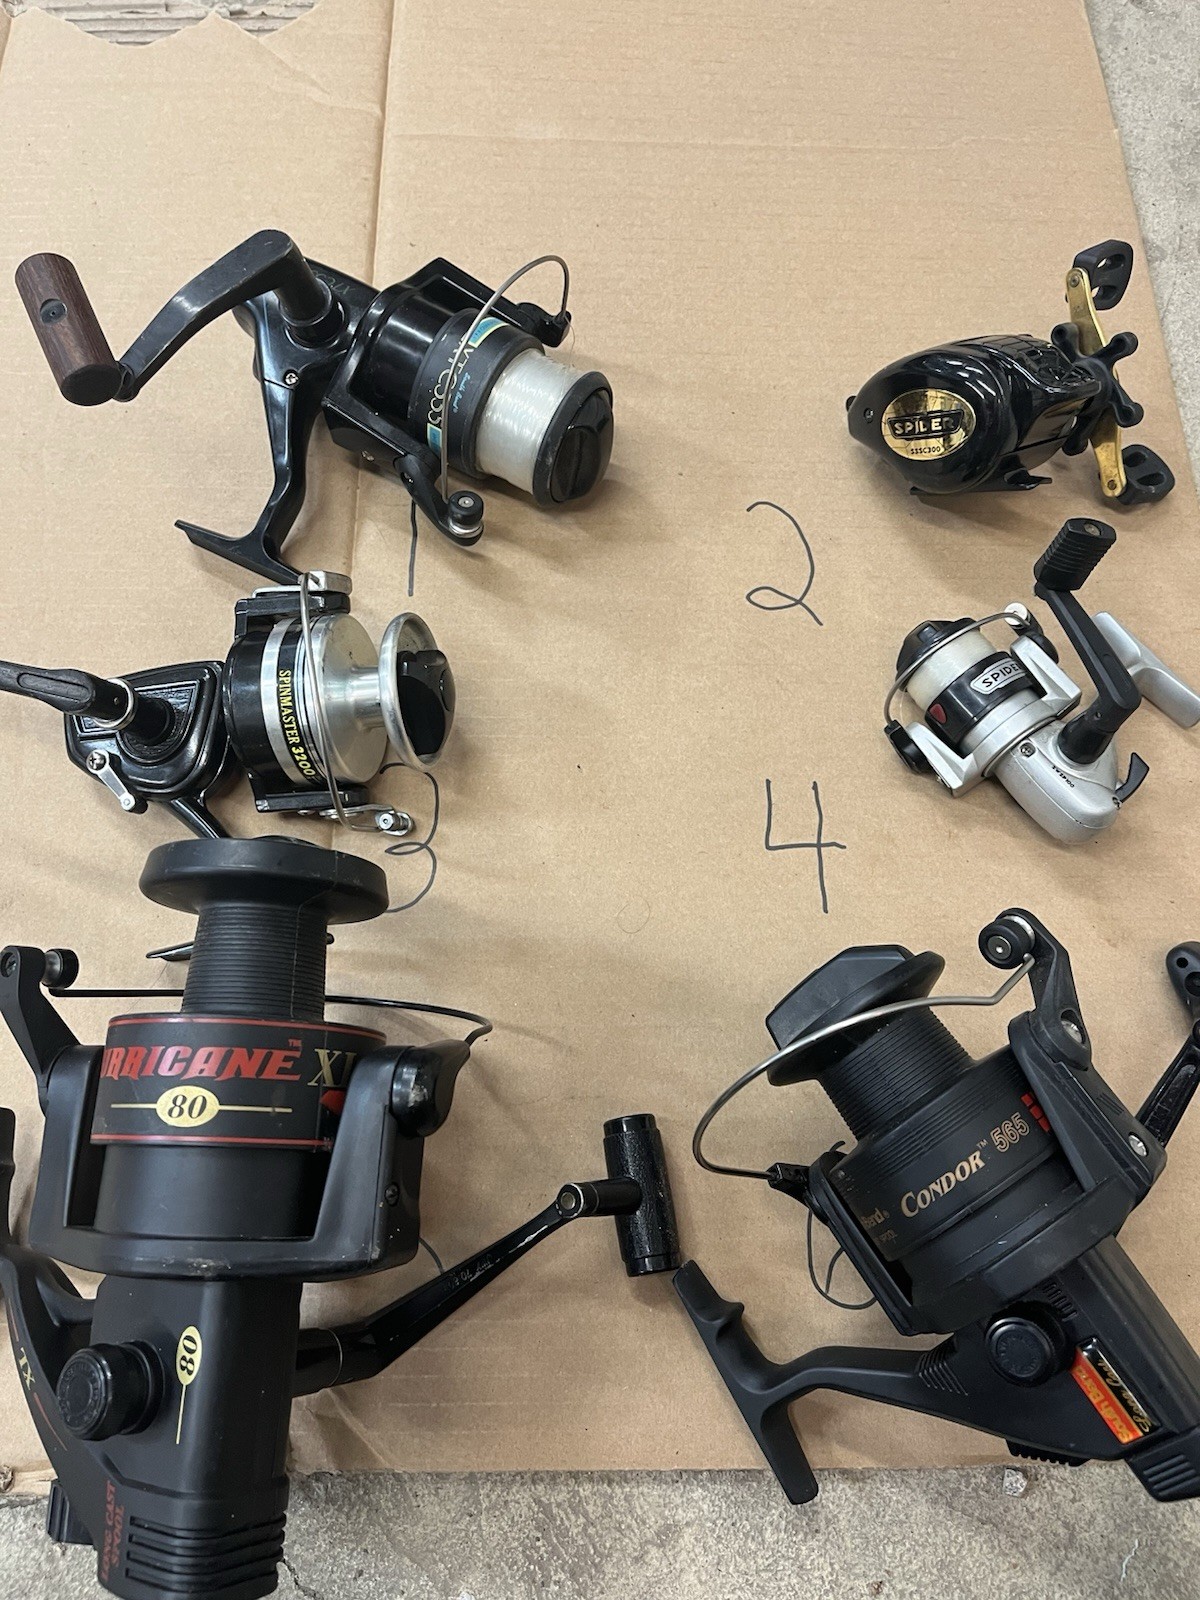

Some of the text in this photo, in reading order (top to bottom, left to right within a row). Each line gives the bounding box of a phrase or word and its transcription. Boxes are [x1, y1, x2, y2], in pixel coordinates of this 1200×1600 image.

[746, 500, 823, 626] 2
[278, 669, 316, 776] SPINMASTER 3200
[765, 778, 847, 914] 4
[167, 1094, 208, 1119] 80
[990, 1111, 1030, 1153] 565
[19, 1347, 36, 1391] XL
[180, 1334, 199, 1376] 80
[1099, 1400, 1134, 1442] South
[105, 1480, 117, 1526] CAST
